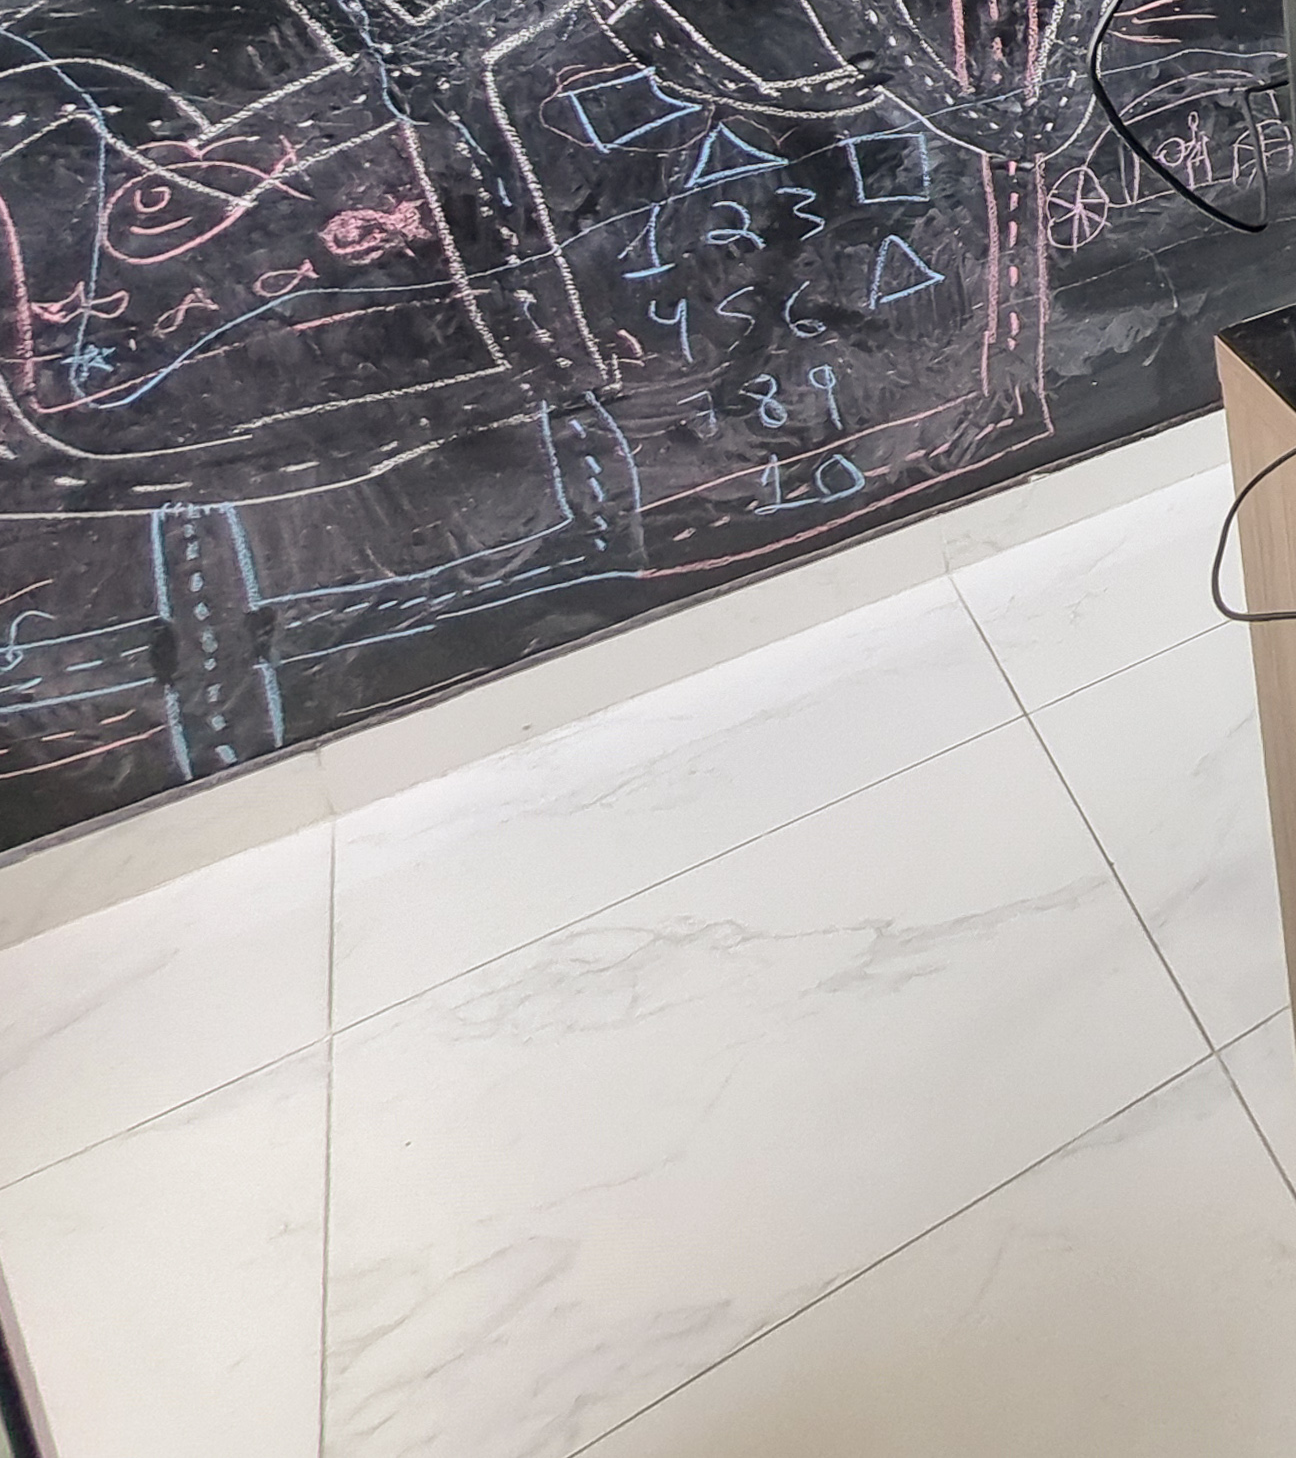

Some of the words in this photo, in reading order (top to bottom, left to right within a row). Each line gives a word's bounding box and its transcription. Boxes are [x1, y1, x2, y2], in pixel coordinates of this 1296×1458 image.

[706, 200, 767, 251] 2
[775, 186, 827, 242] 3
[785, 280, 828, 339] 6
[739, 373, 789, 429] 8
[808, 363, 844, 431] 9
